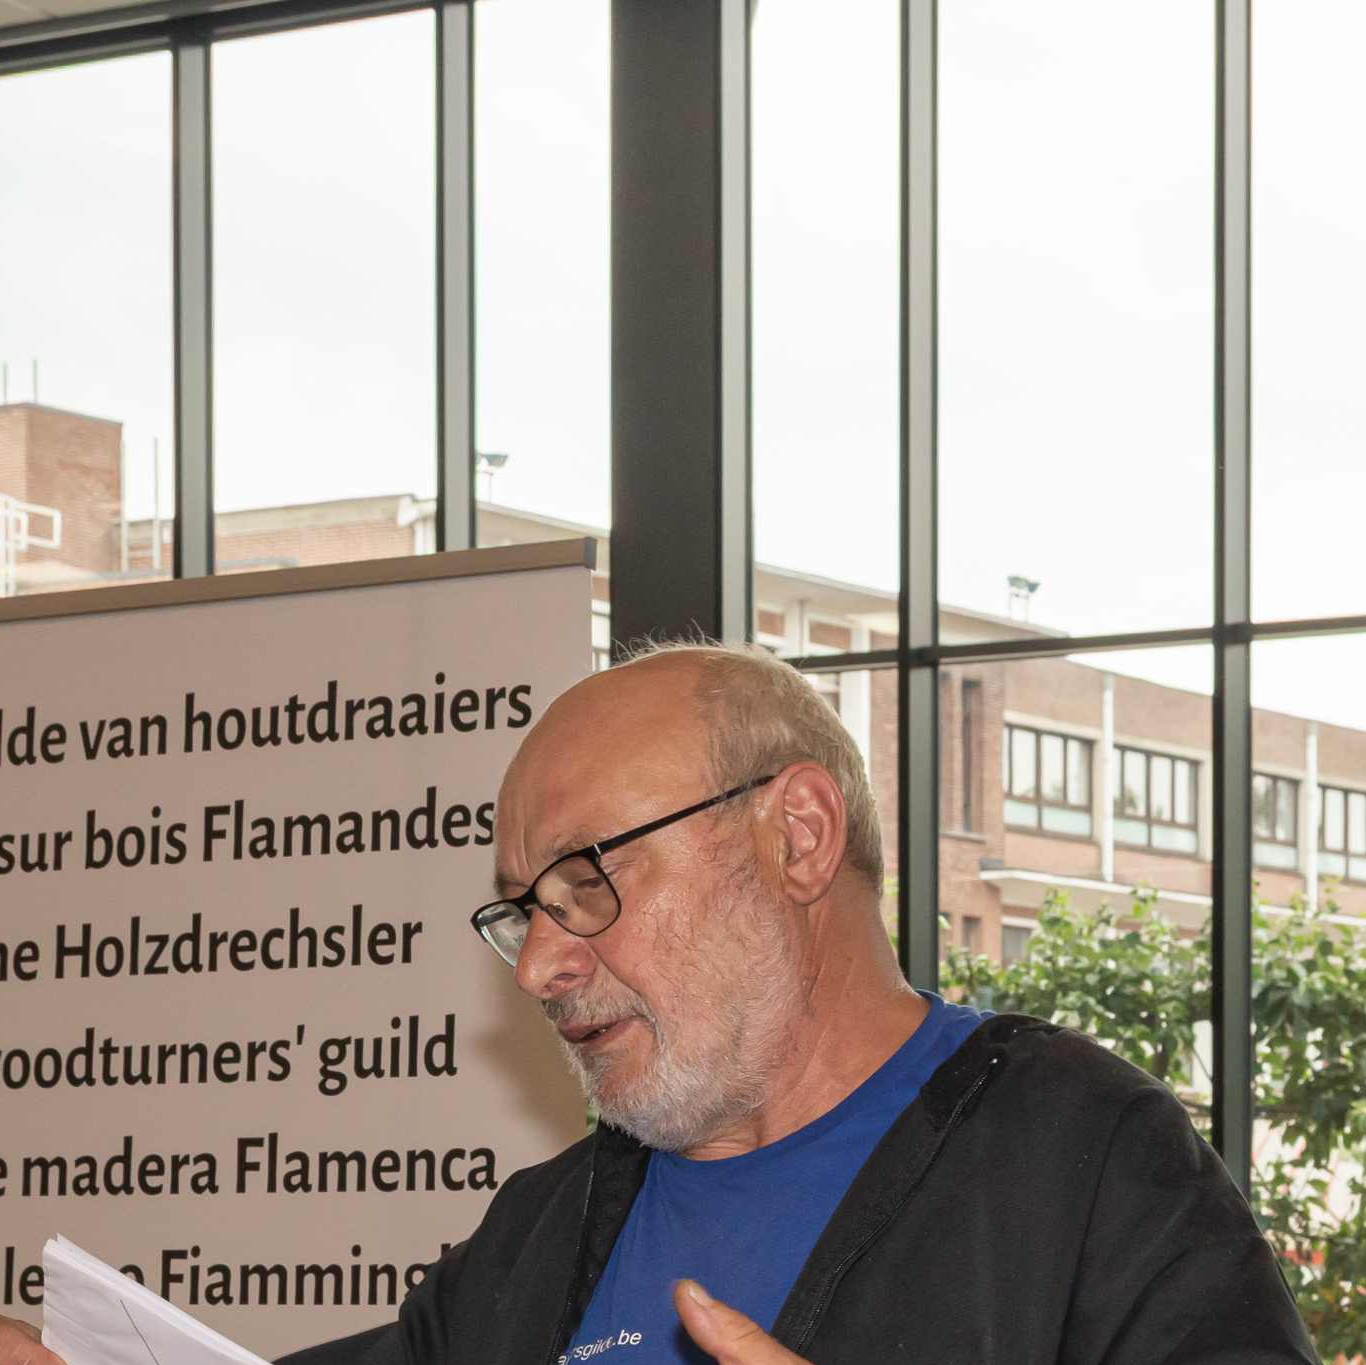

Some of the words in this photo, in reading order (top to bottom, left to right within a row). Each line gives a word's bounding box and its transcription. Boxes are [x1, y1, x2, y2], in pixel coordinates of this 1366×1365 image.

[79, 714, 168, 761] van
[183, 671, 532, 753] houtdraaiers
[84, 805, 187, 870] bois
[202, 786, 495, 862] Flamandes
[54, 903, 423, 980] Holzdrechsler
[318, 1013, 458, 1097] guild
[21, 1135, 220, 1197] madera
[236, 1132, 499, 1194] Flamenca
